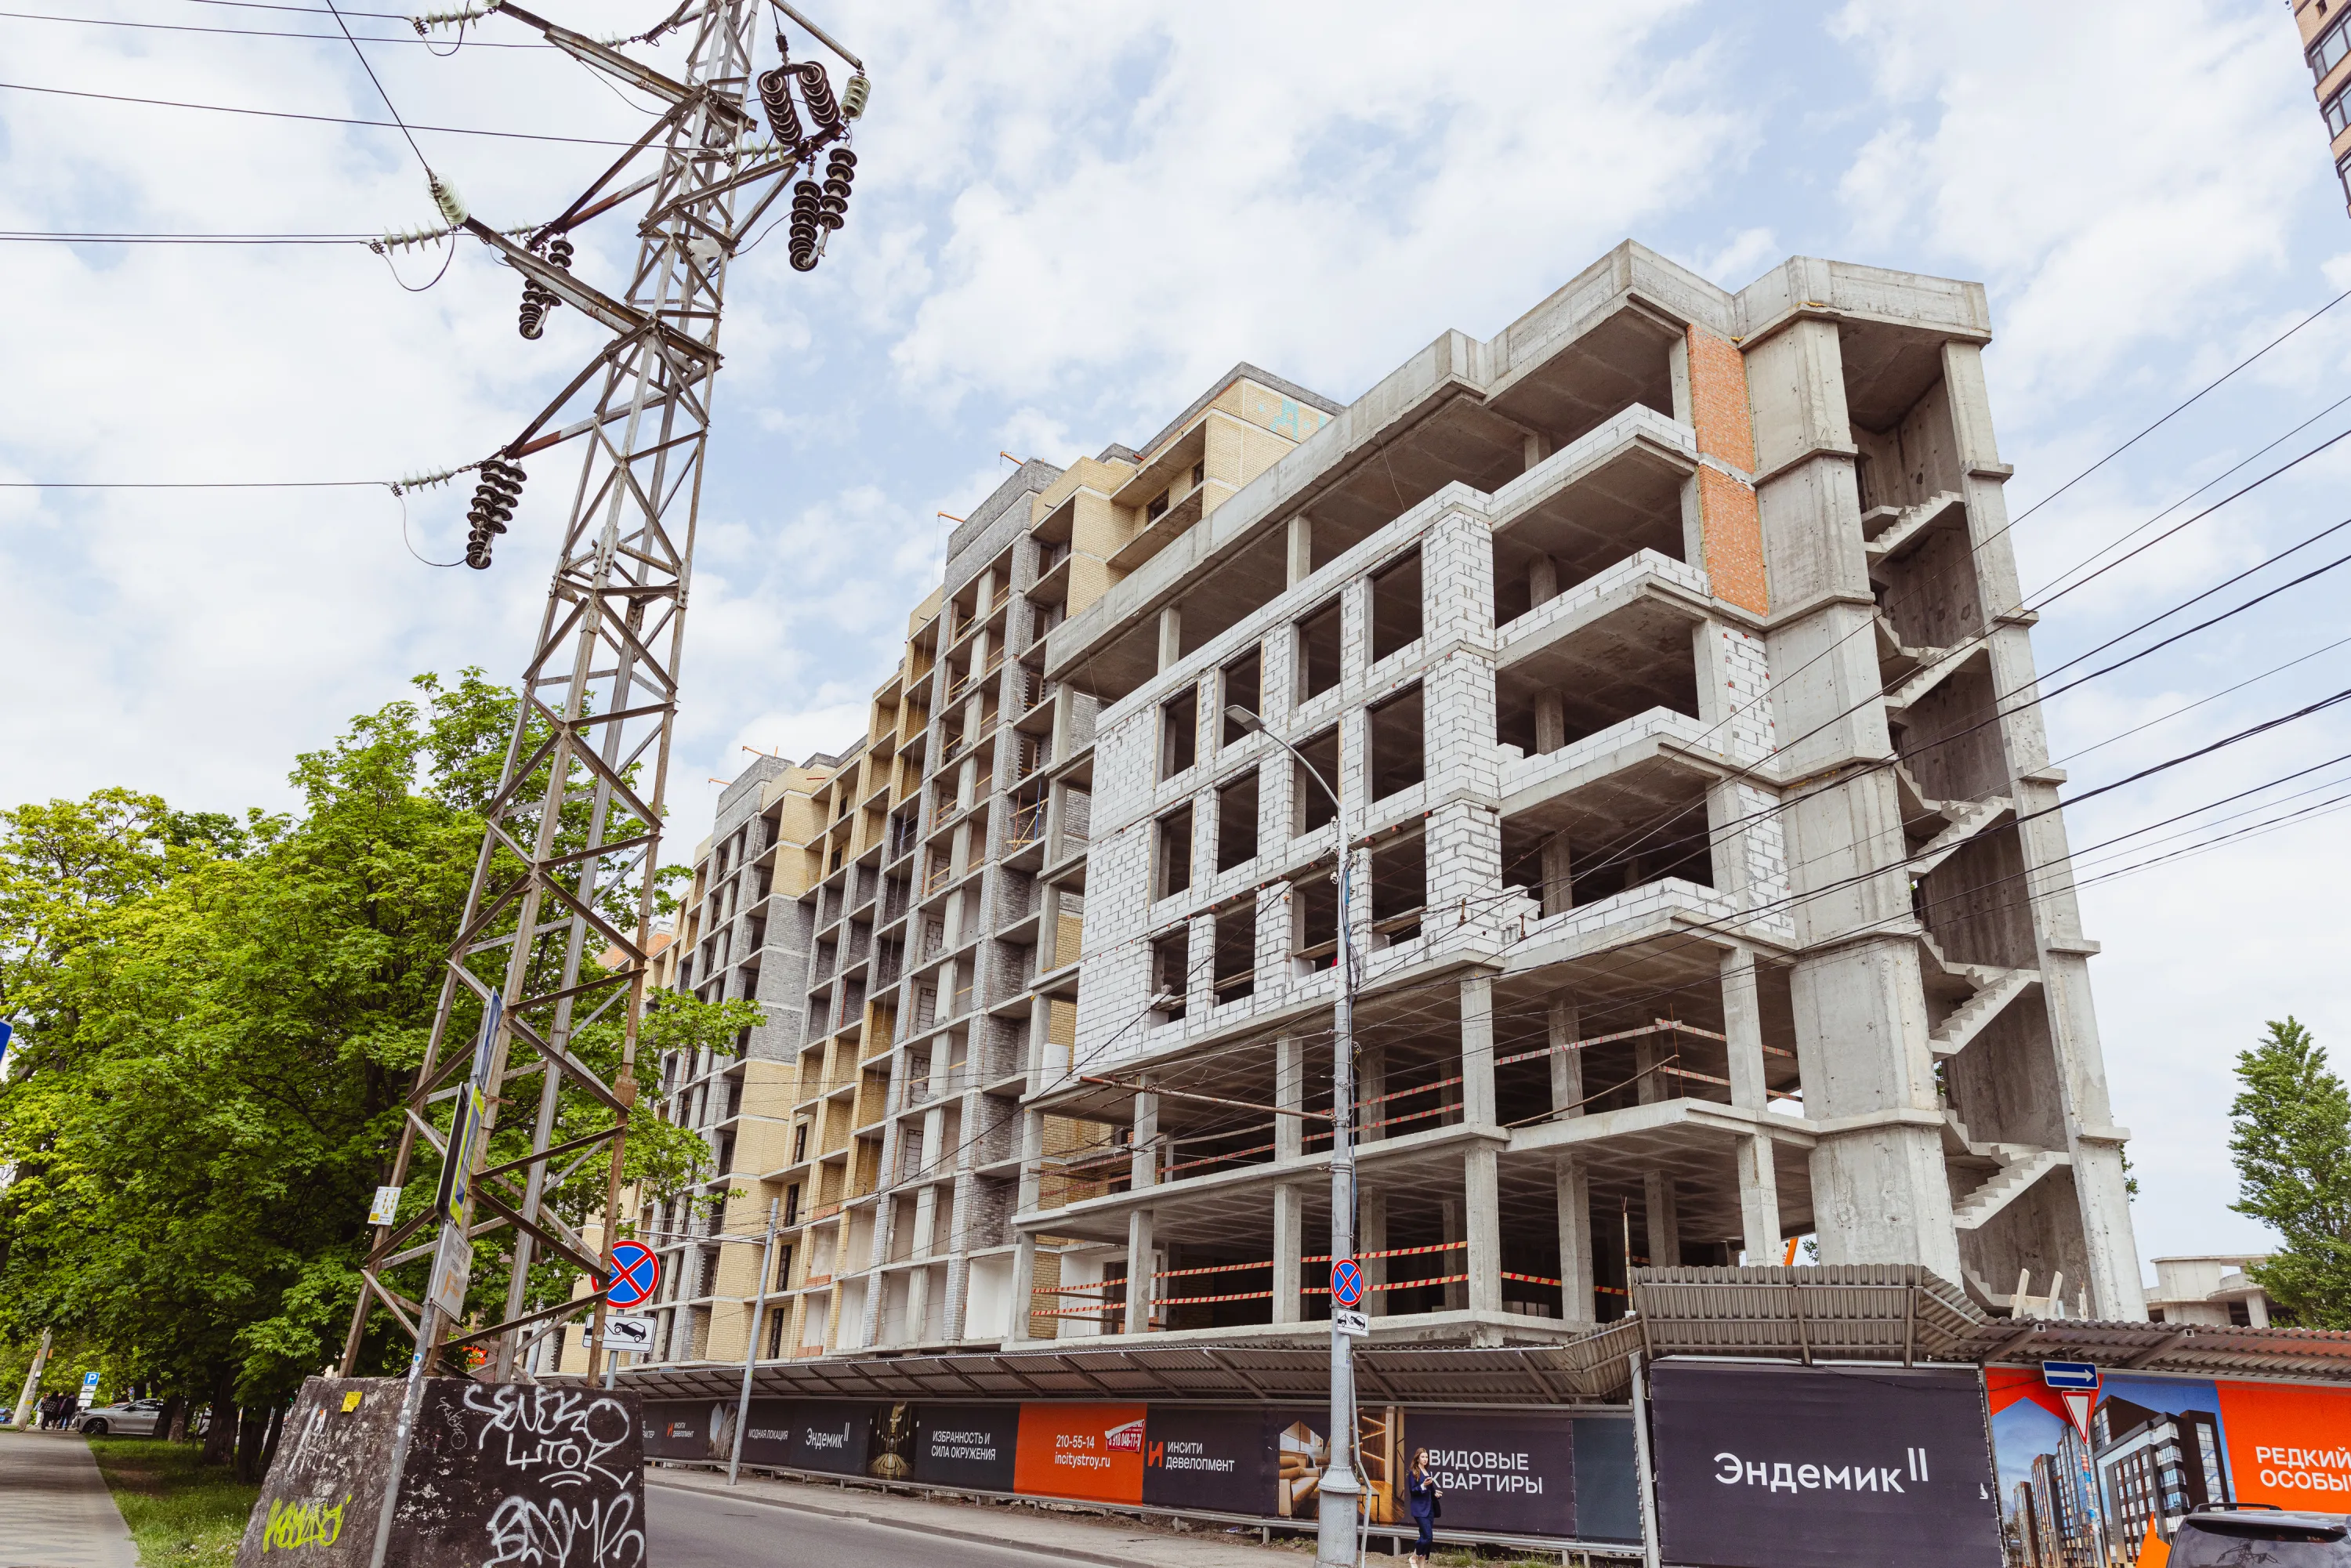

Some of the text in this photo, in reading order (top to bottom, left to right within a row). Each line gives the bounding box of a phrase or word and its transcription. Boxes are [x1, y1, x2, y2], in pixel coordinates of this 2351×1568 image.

[748, 1429, 788, 1441] МОДНАЯ ЛОКАЦИЯ
[806, 1428, 843, 1450] Эндемик
[933, 1430, 991, 1445] ИЗБРАННОСТЬ И
[1056, 1435, 1096, 1449] 210-55-14
[931, 1445, 996, 1461] СИЛА ОКРУЖЕНИЯ
[1054, 1451, 1111, 1470] incitystroy.ru
[1429, 1449, 1529, 1471] ВИДОВЫЕ
[2255, 1446, 2351, 1469] РЕДКИЙ
[1430, 1471, 1543, 1494] КВАРТИРЫ
[1713, 1452, 1906, 1494] Эндемик
[2259, 1468, 2351, 1491] ОСОБЫ
